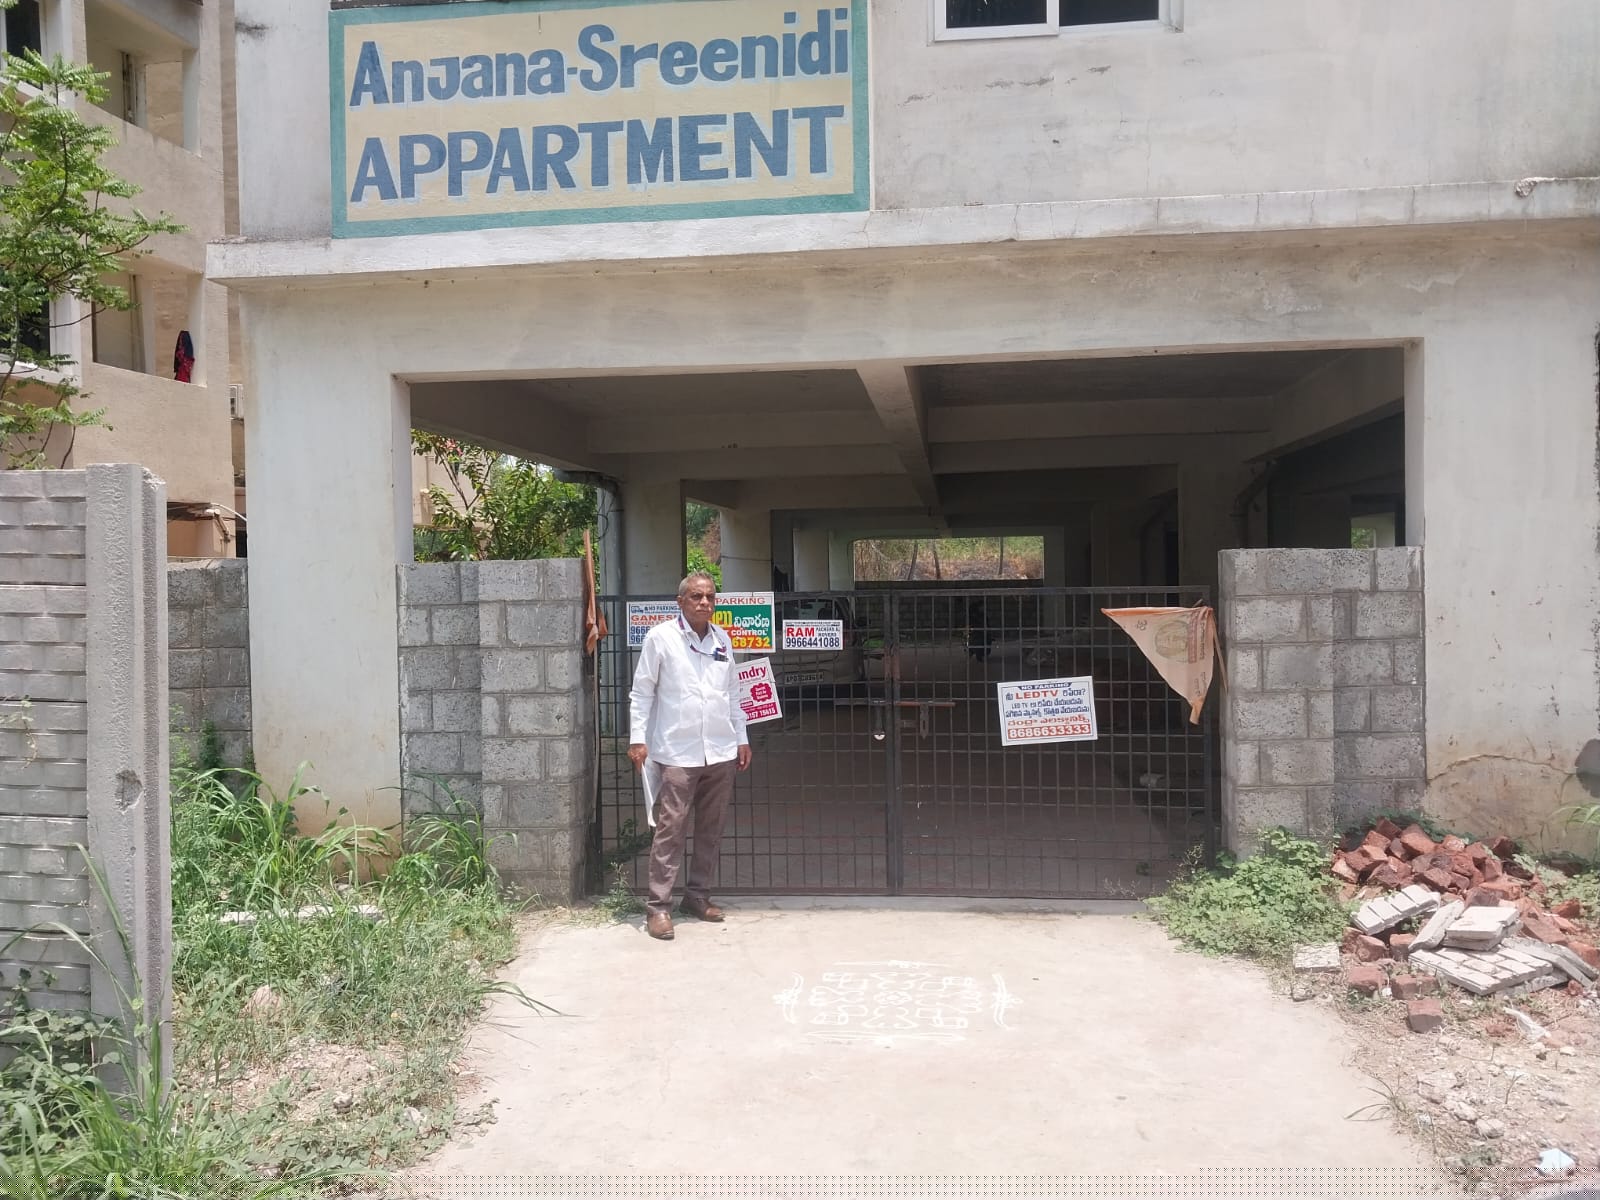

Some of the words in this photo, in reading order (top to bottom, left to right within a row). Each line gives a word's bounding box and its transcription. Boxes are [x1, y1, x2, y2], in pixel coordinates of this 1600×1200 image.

[350, 104, 845, 203] APPARTMENT
[715, 597, 766, 605] PARKING
[631, 614, 678, 622] GANES
[786, 627, 815, 637] RAM
[786, 637, 840, 648] 9966441088
[1009, 724, 1090, 738] 8686633333
